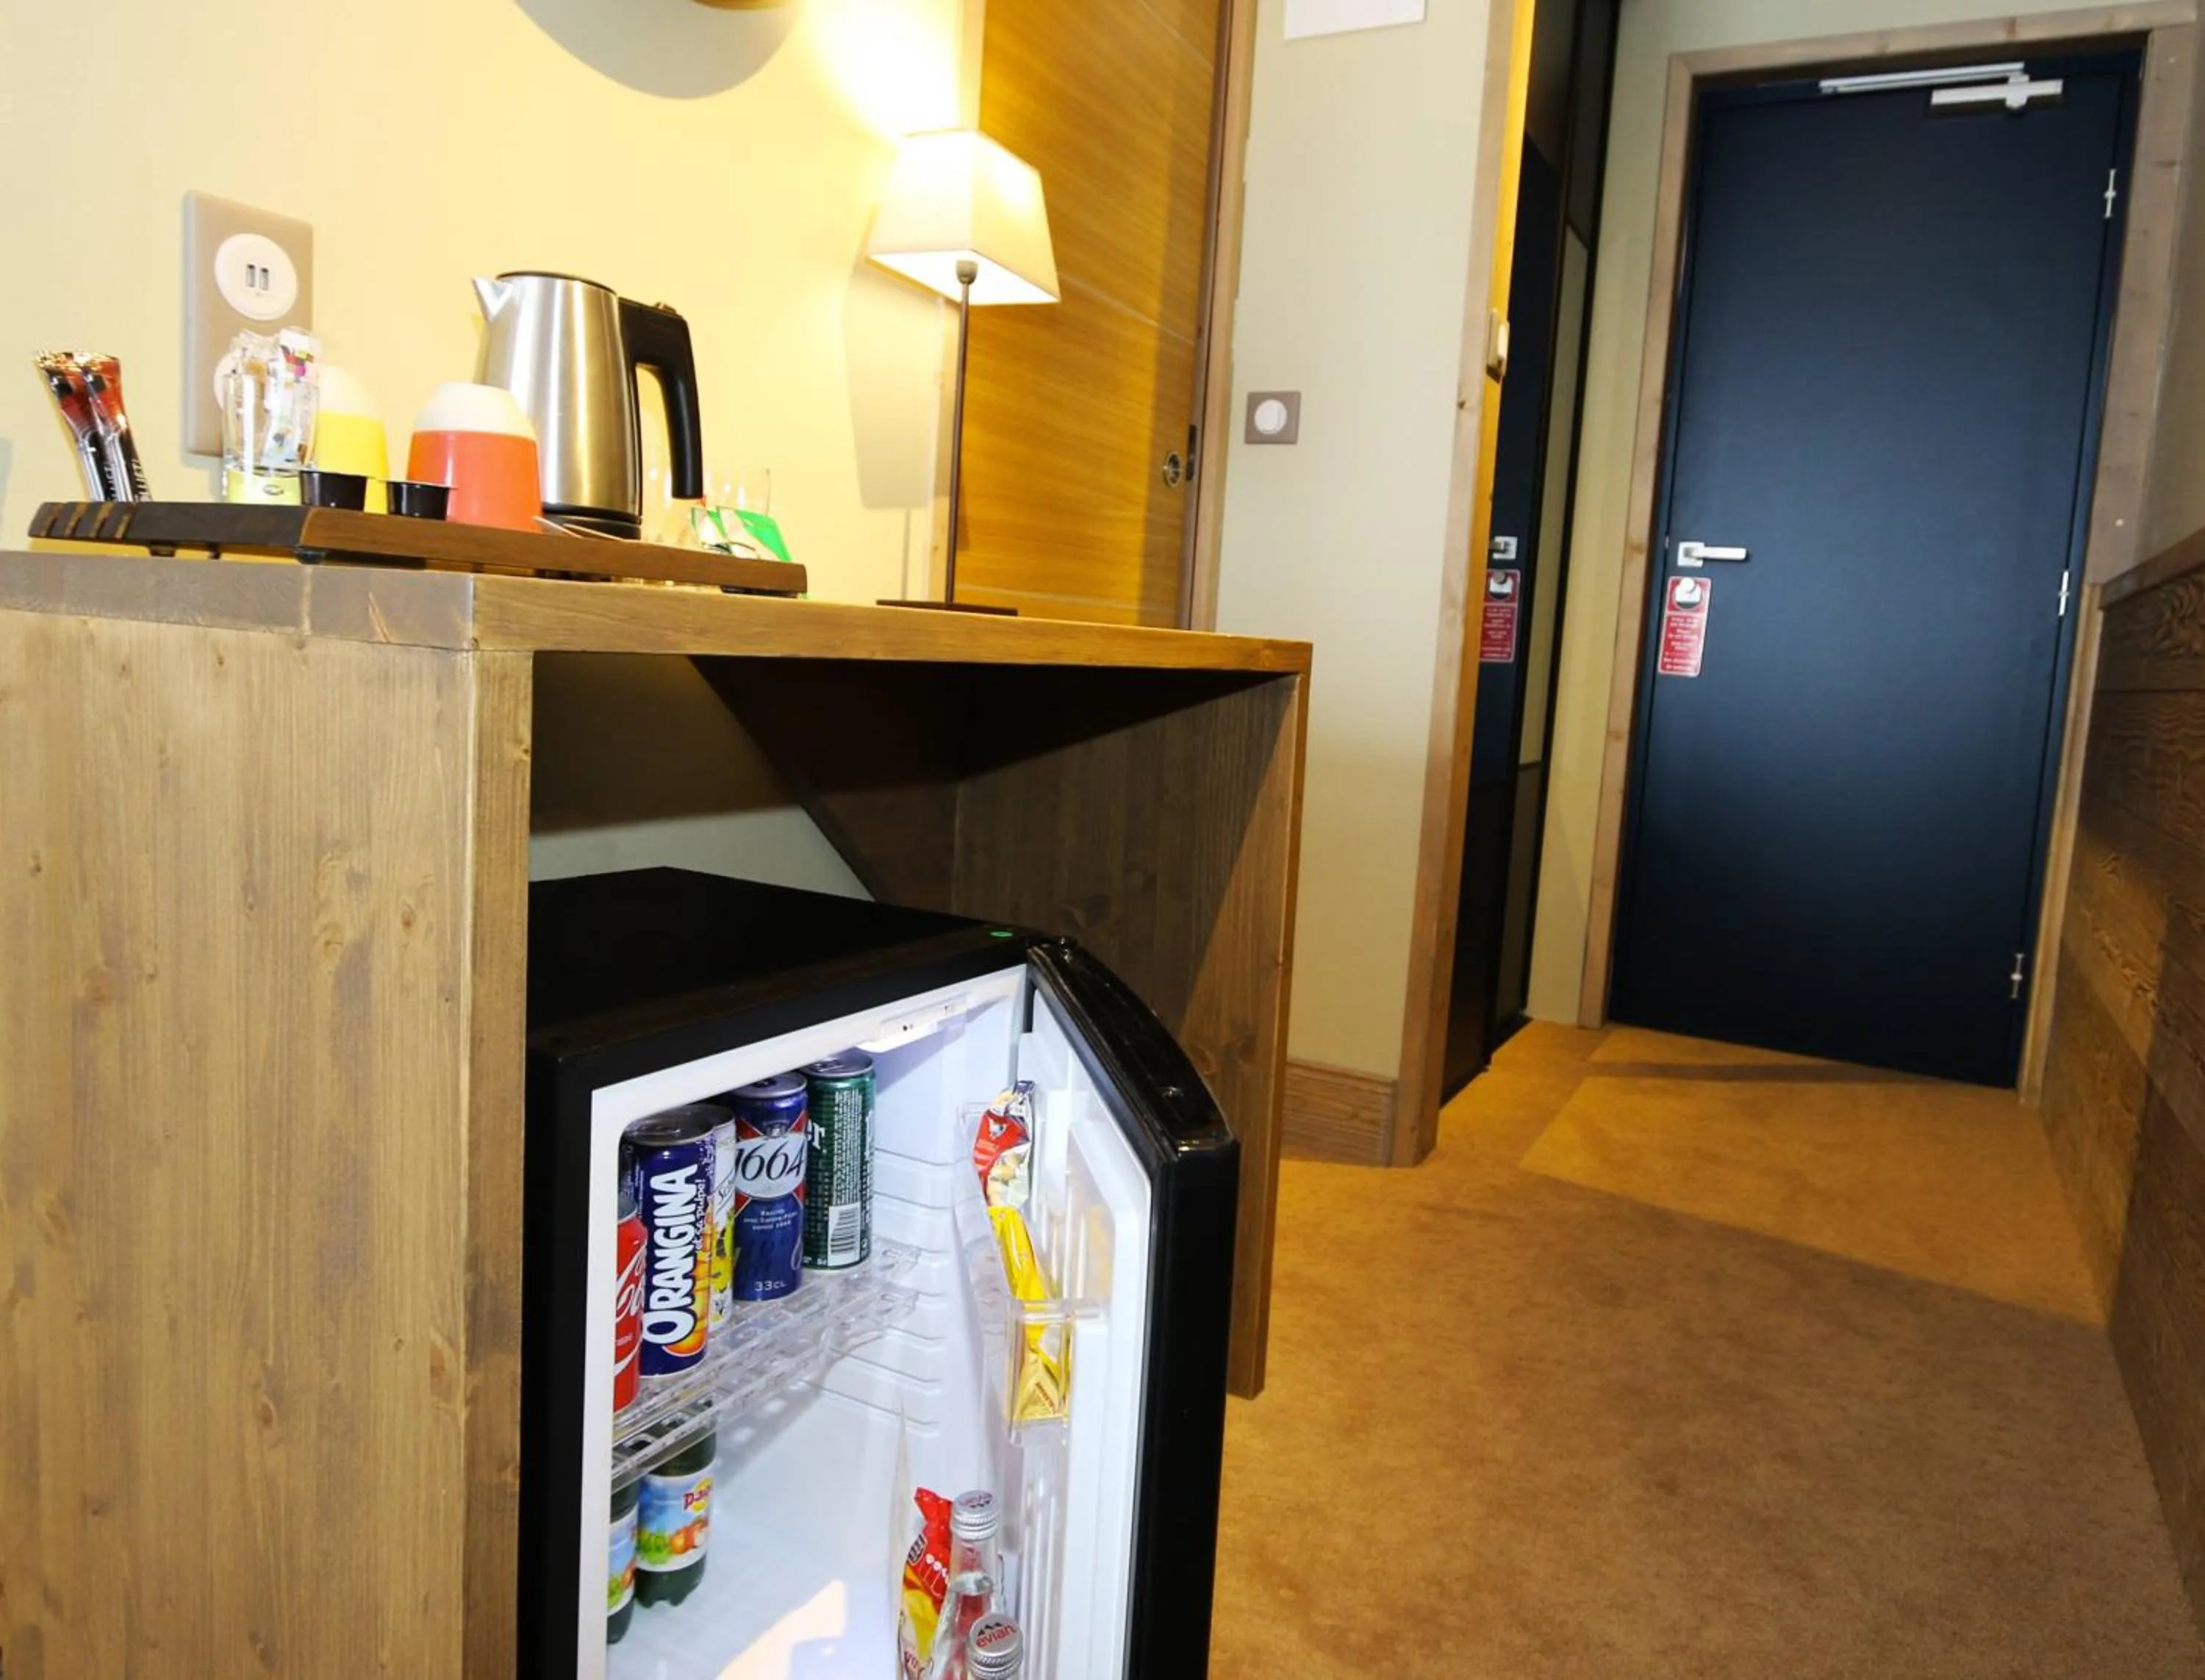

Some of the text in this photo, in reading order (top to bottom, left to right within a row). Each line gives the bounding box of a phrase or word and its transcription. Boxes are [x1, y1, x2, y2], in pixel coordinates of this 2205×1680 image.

[735, 1140, 806, 1182] 1664
[643, 1163, 698, 1344] ORANGINA
[975, 1624, 1017, 1648] evian
